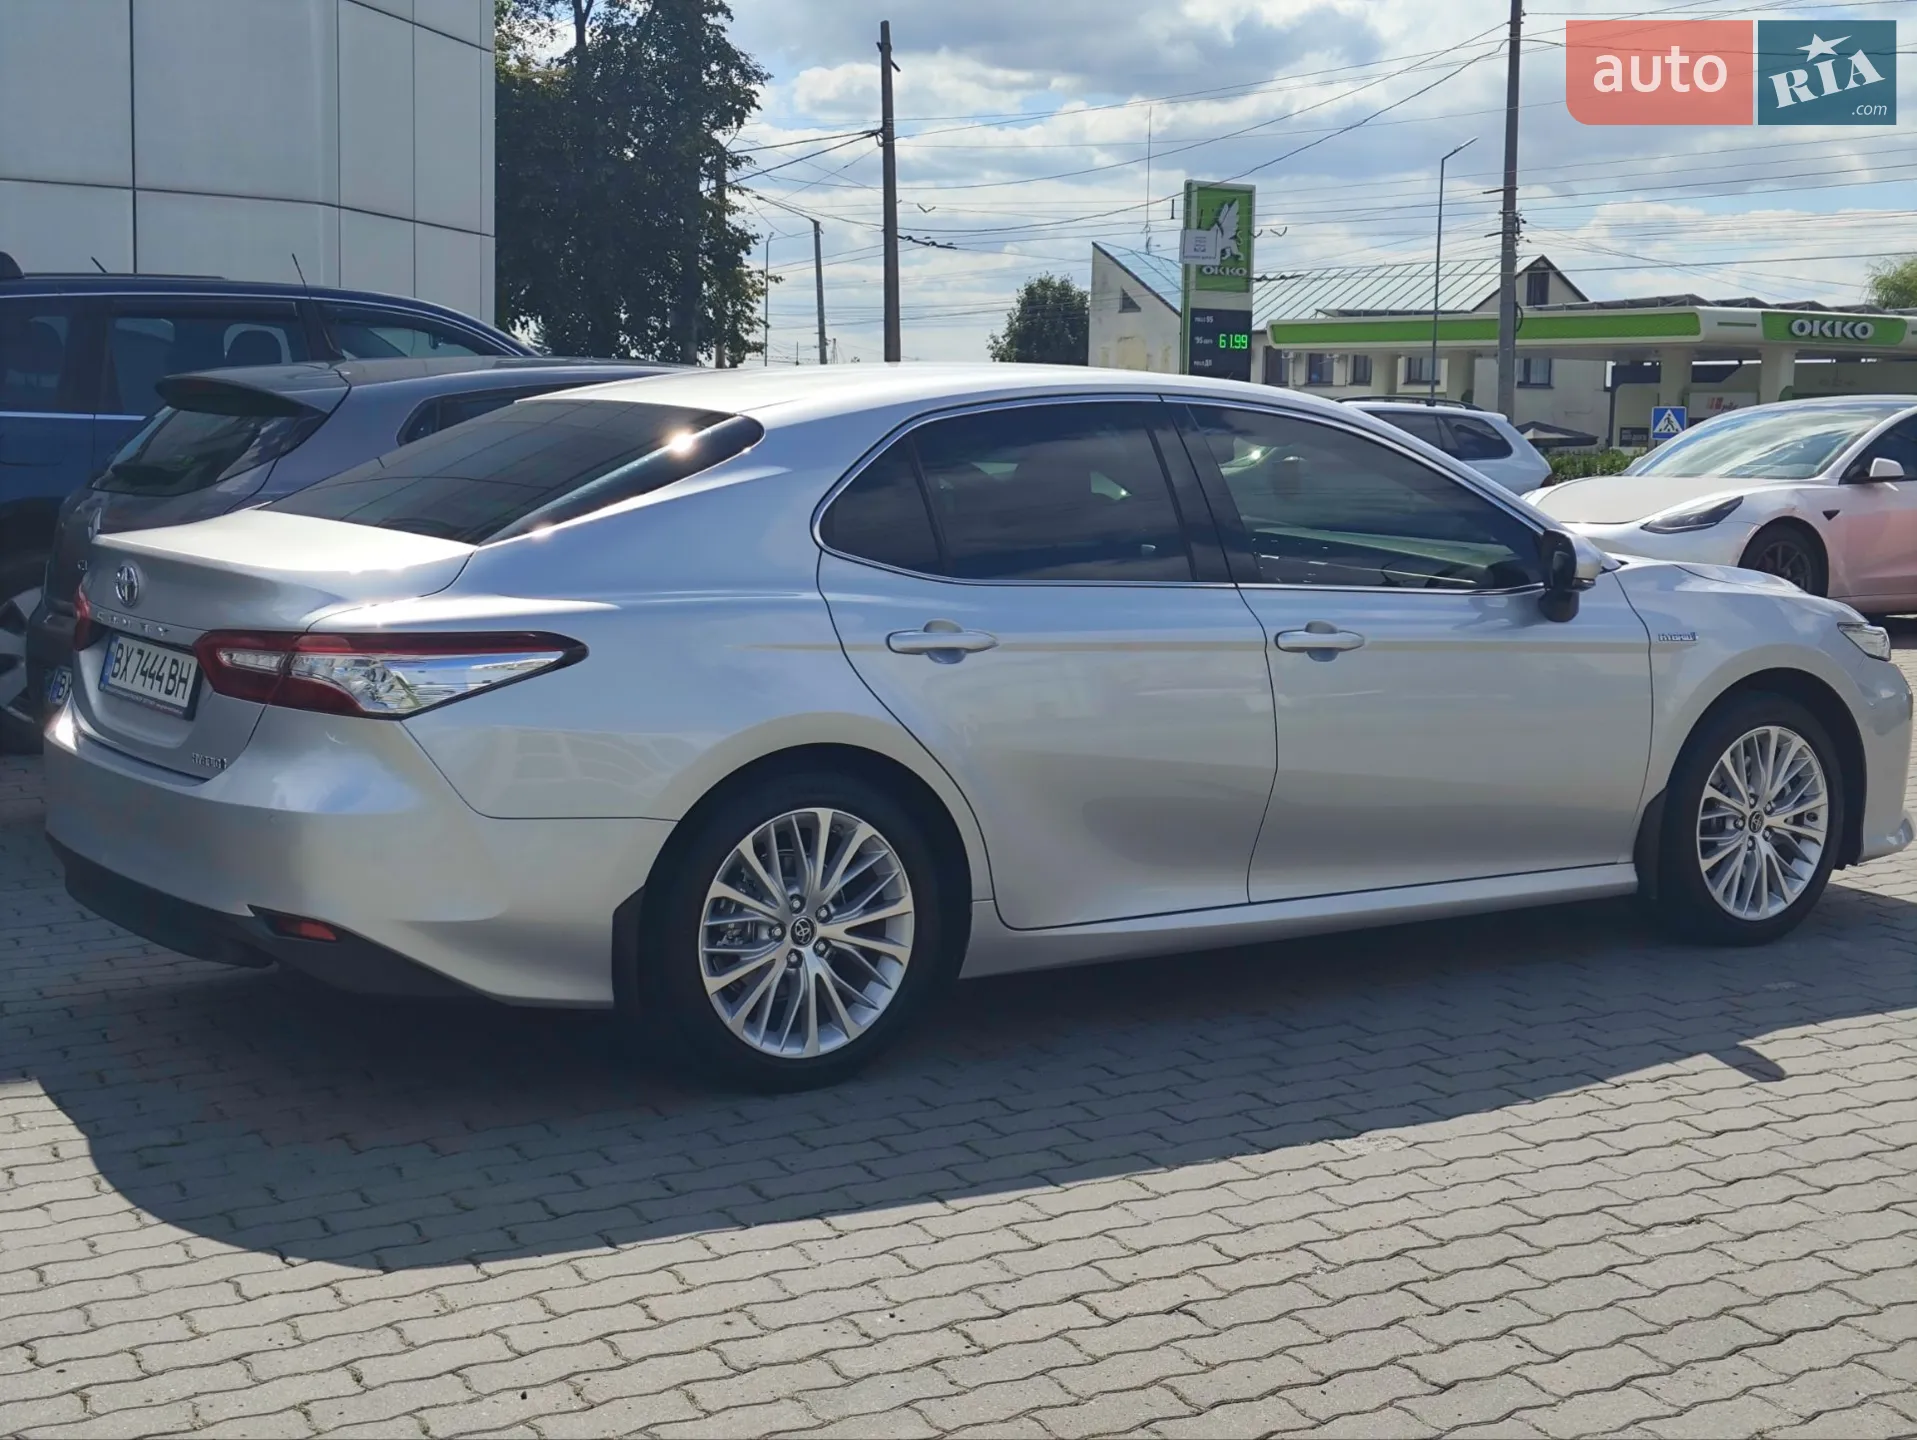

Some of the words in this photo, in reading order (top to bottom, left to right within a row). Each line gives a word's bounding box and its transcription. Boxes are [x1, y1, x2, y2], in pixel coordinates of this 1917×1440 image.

[1201, 265, 1248, 276] OKKO
[1790, 318, 1875, 340] OKKO
[1219, 333, 1248, 349] 61.99
[111, 643, 134, 682] BX
[130, 650, 168, 692] 7444
[164, 658, 192, 699] BH
